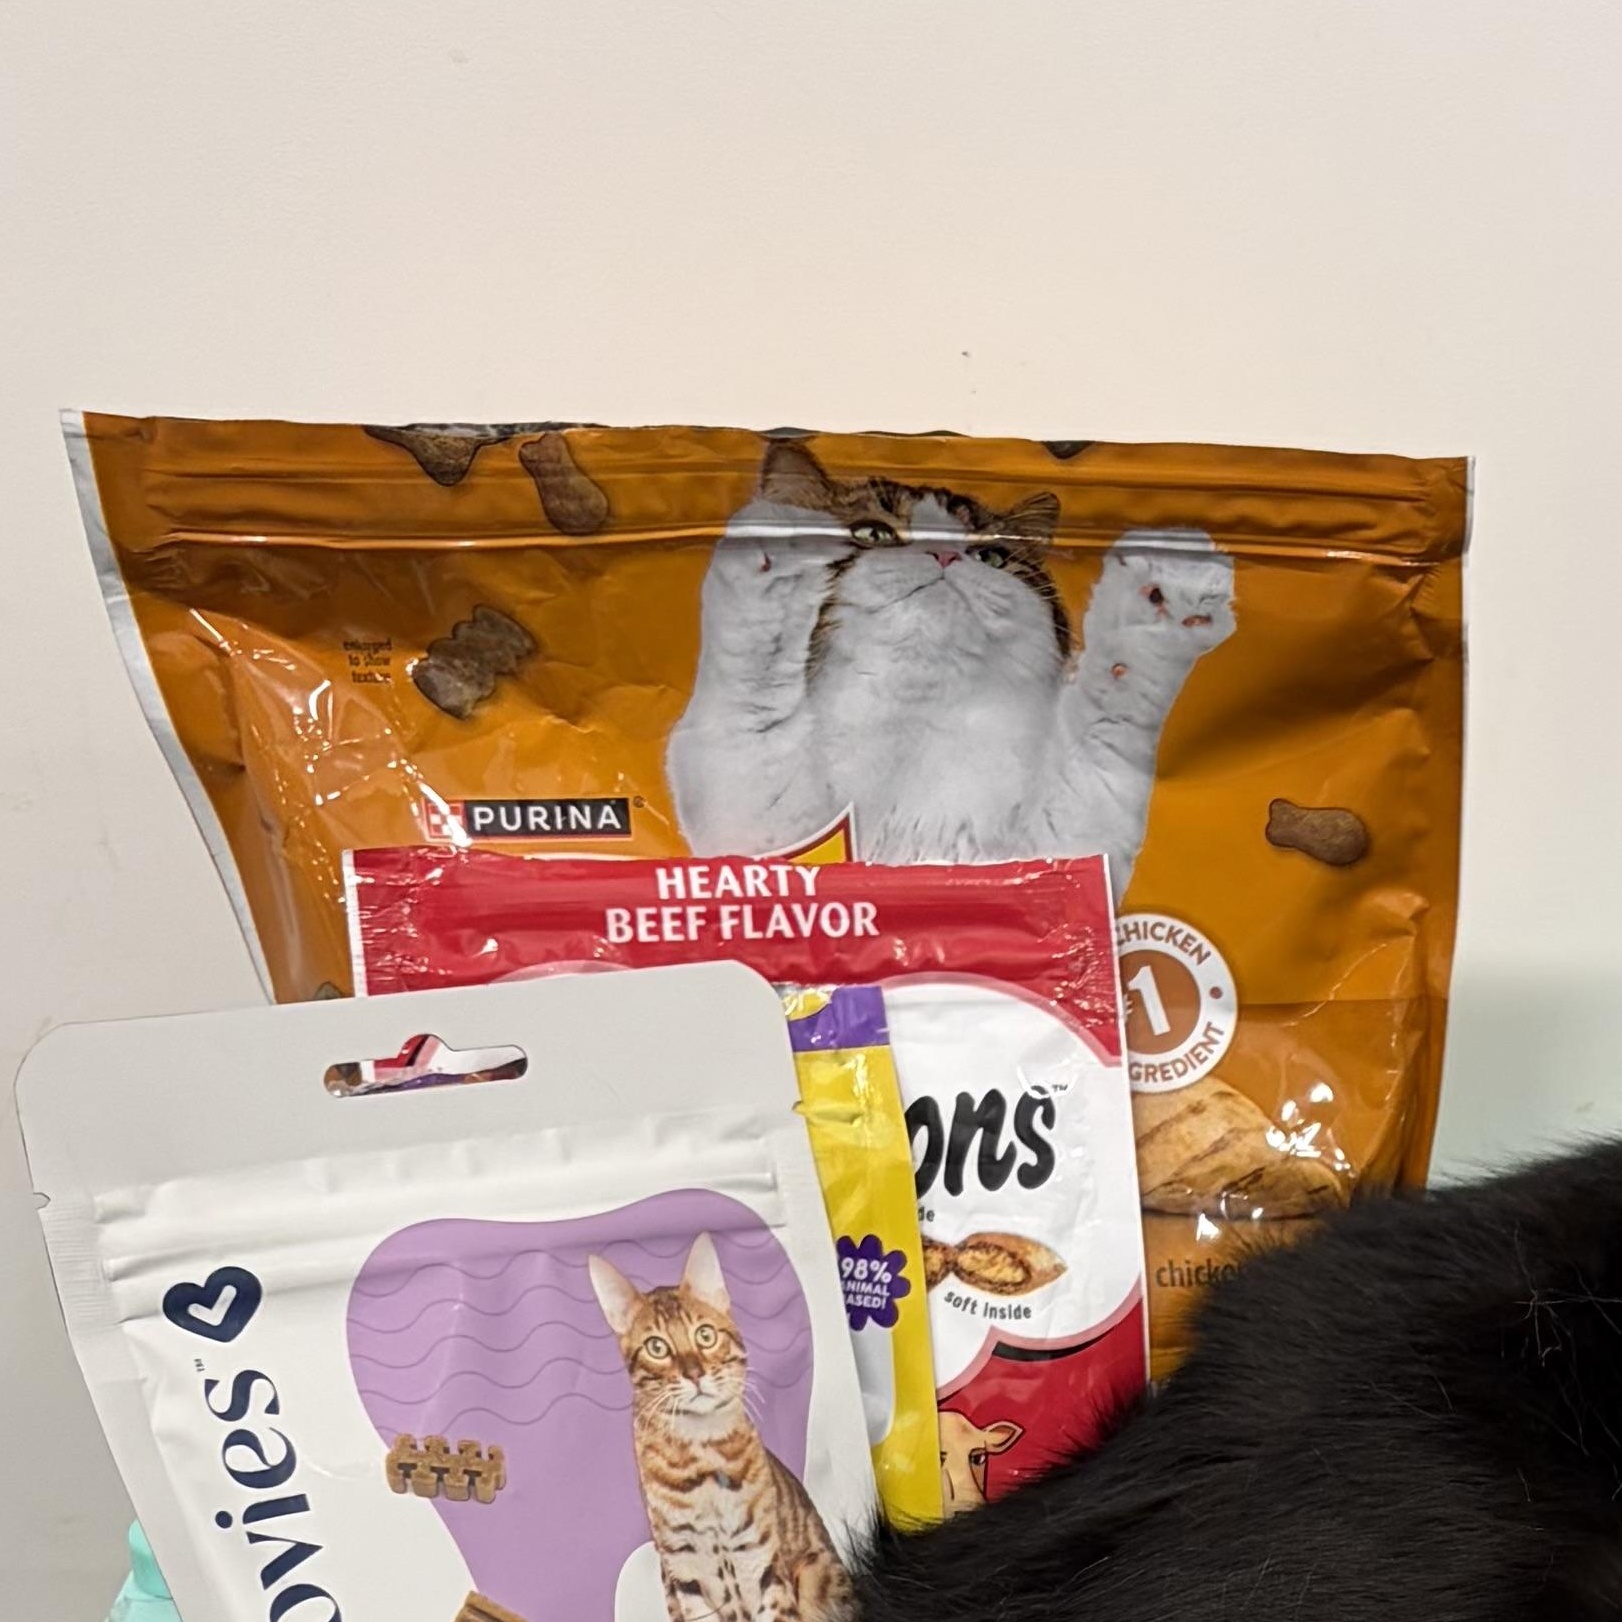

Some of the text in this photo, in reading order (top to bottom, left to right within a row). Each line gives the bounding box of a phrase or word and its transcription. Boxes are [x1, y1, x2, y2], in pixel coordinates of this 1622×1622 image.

[473, 804, 622, 832] PURINA
[655, 865, 821, 900] HEARTY
[605, 902, 880, 943] BEEF FLAVOR
[1129, 1021, 1224, 1083] GREDIENT
[840, 1257, 893, 1284] 98%
[845, 1294, 887, 1310] ASED!
[944, 1291, 1032, 1320] soft inside
